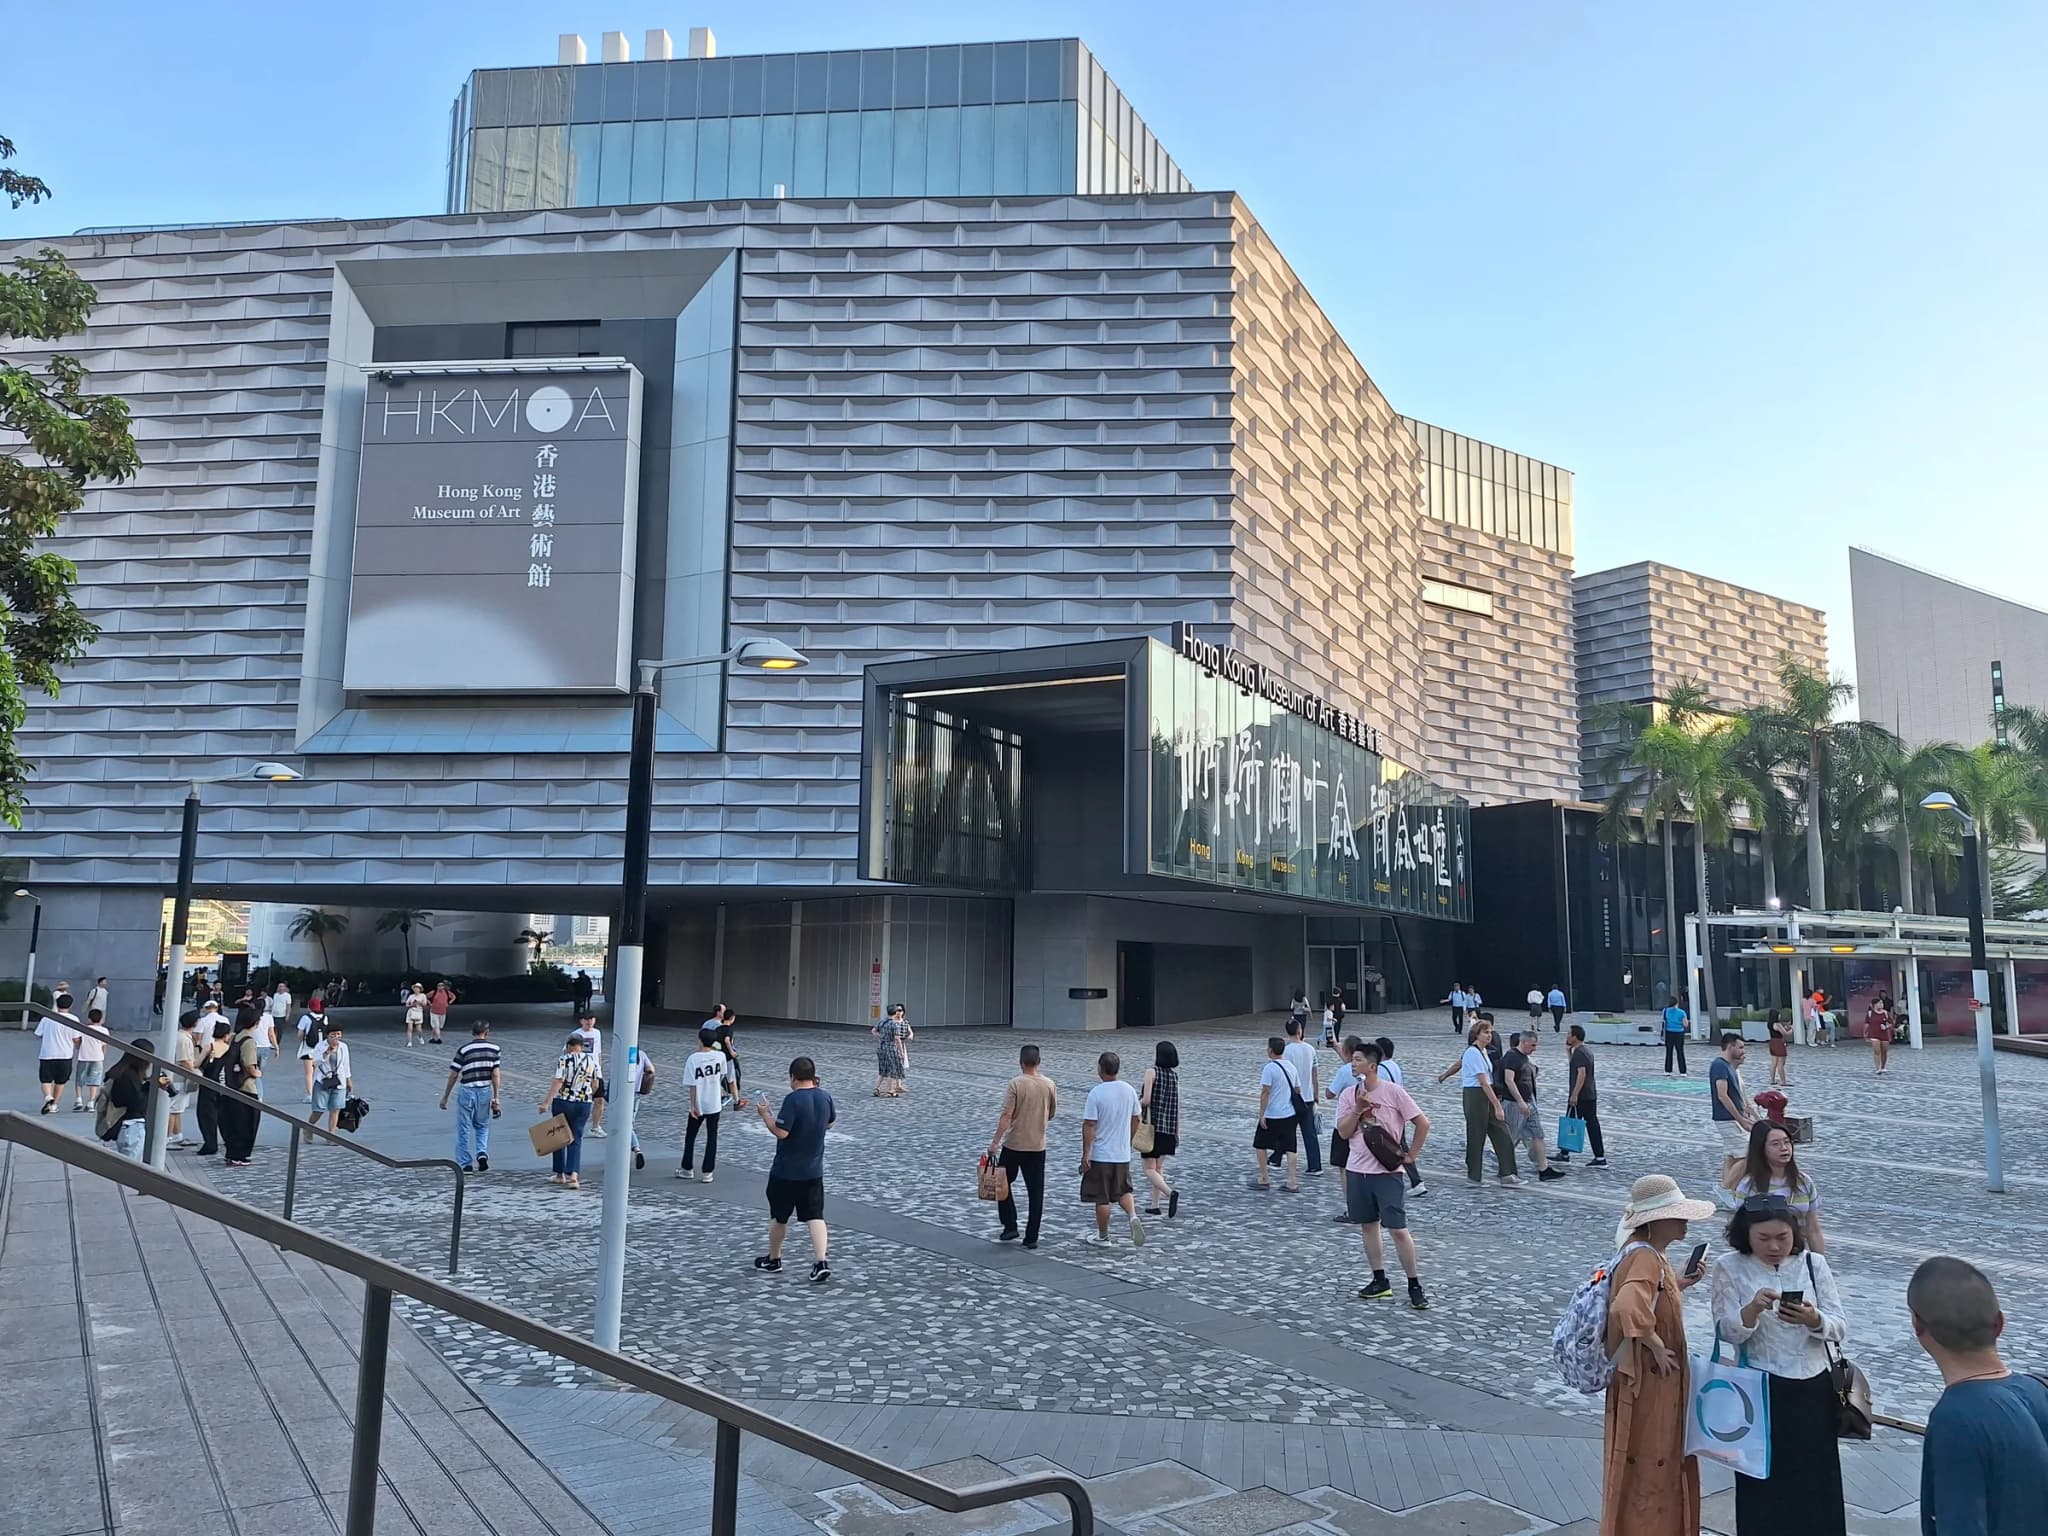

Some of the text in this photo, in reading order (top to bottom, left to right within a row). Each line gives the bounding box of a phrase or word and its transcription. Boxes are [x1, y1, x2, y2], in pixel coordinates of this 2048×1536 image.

[383, 386, 615, 435] HKMOA
[412, 504, 521, 519] Museum of Art
[437, 484, 522, 501] Hong Kong
[528, 444, 559, 587] 香港藝術館
[1183, 621, 1335, 731] Hong Kong Museum of Art
[1190, 837, 1211, 860] Hong
[1236, 848, 1254, 869] Kong
[1271, 856, 1297, 874] Museum
